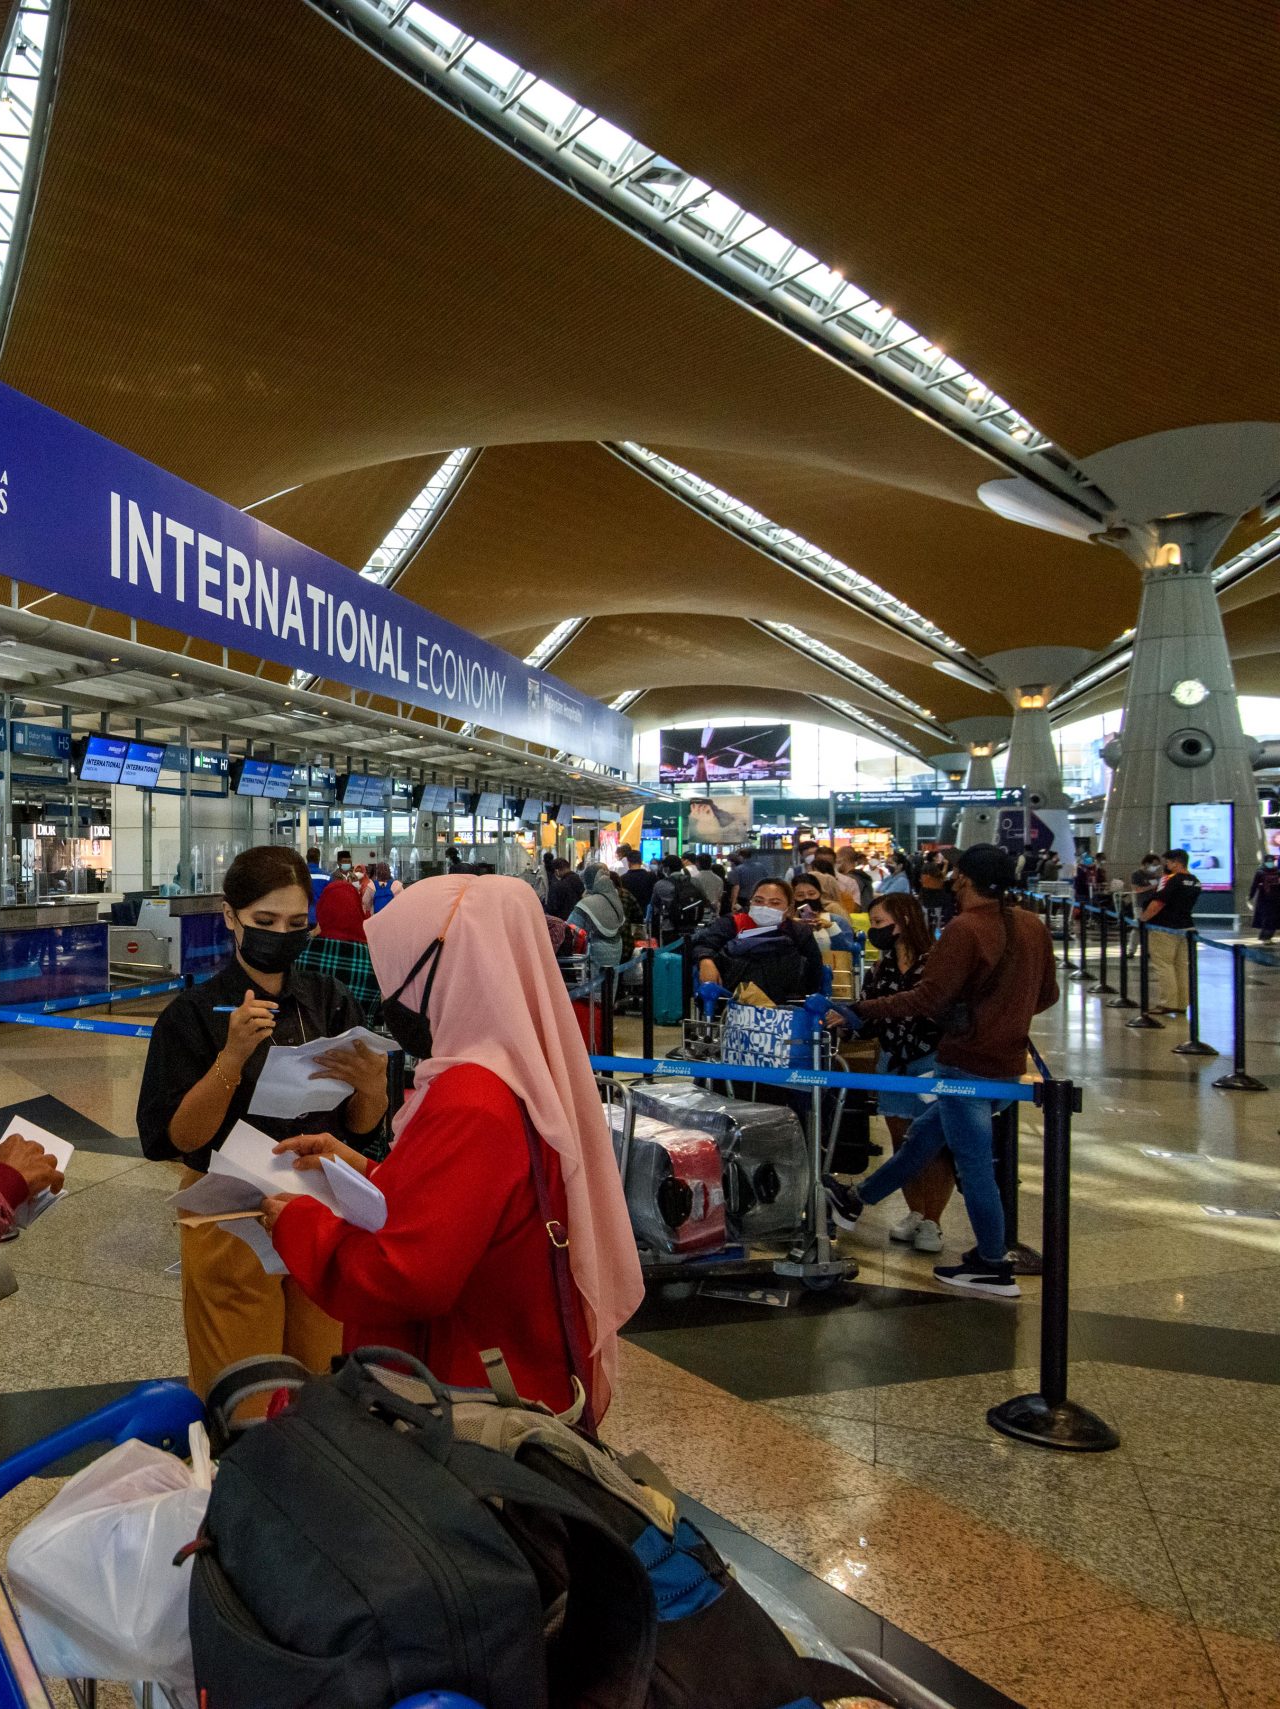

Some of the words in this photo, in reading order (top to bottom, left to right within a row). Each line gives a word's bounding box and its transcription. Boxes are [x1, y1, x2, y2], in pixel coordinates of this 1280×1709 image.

[110, 491, 409, 684] INTERNATIONAL
[416, 635, 506, 717] ECONOMY
[58, 736, 70, 751] H5
[86, 758, 121, 769] INTERNATIONAL
[179, 752, 188, 767] H6
[220, 758, 229, 771] H7
[125, 763, 159, 774] INTERNATIONAL
[93, 825, 111, 837] DIOR
